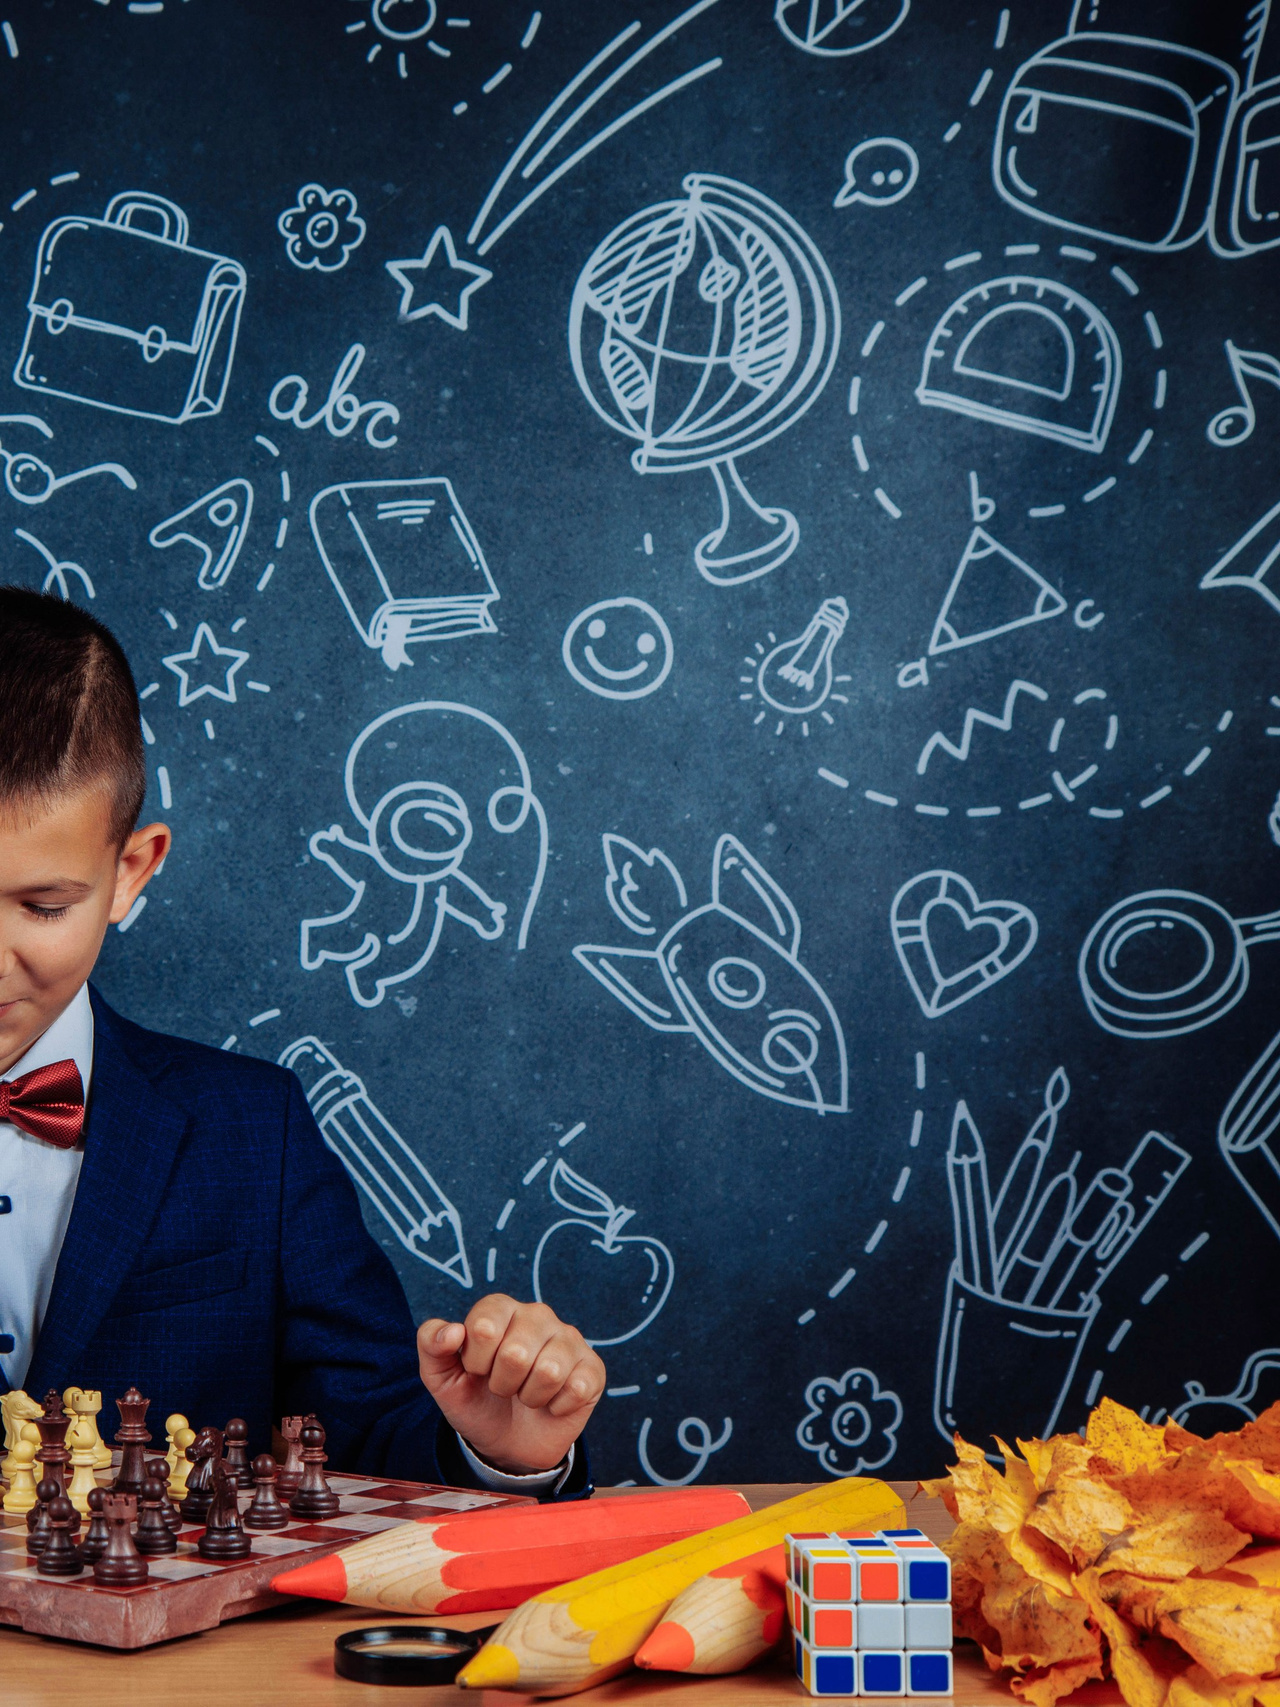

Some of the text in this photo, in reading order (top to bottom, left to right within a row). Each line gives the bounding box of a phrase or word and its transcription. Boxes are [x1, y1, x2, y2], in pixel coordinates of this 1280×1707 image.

[268, 343, 400, 449] abc
[970, 471, 996, 522] b
[1074, 599, 1105, 628] c
[897, 657, 929, 688] a
